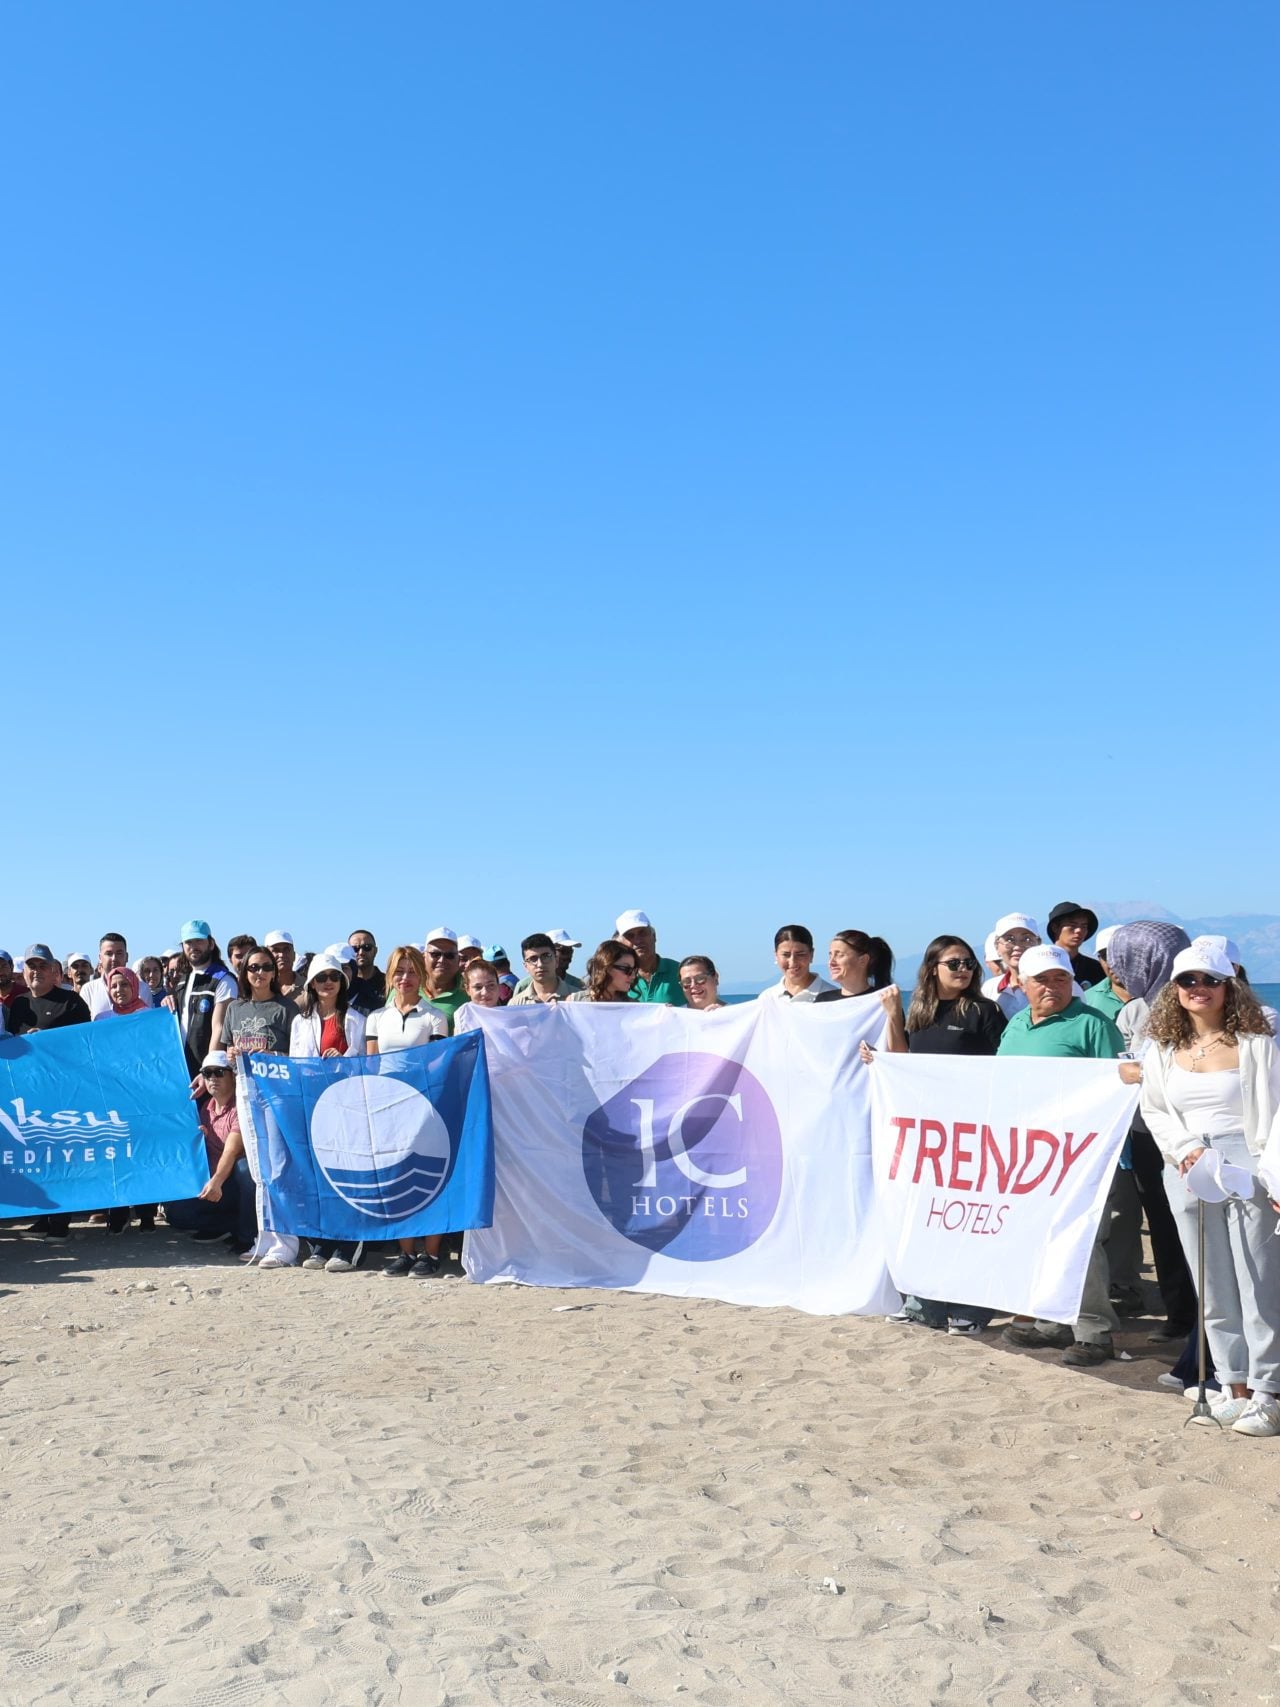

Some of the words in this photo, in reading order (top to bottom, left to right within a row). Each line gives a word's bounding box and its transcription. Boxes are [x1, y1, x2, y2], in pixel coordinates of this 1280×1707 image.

[251, 1060, 290, 1080] 2025
[630, 1092, 747, 1188] IC
[888, 1116, 1099, 1196] TRENDY
[631, 1195, 749, 1218] HOTELS
[926, 1197, 1010, 1235] HOTELS
